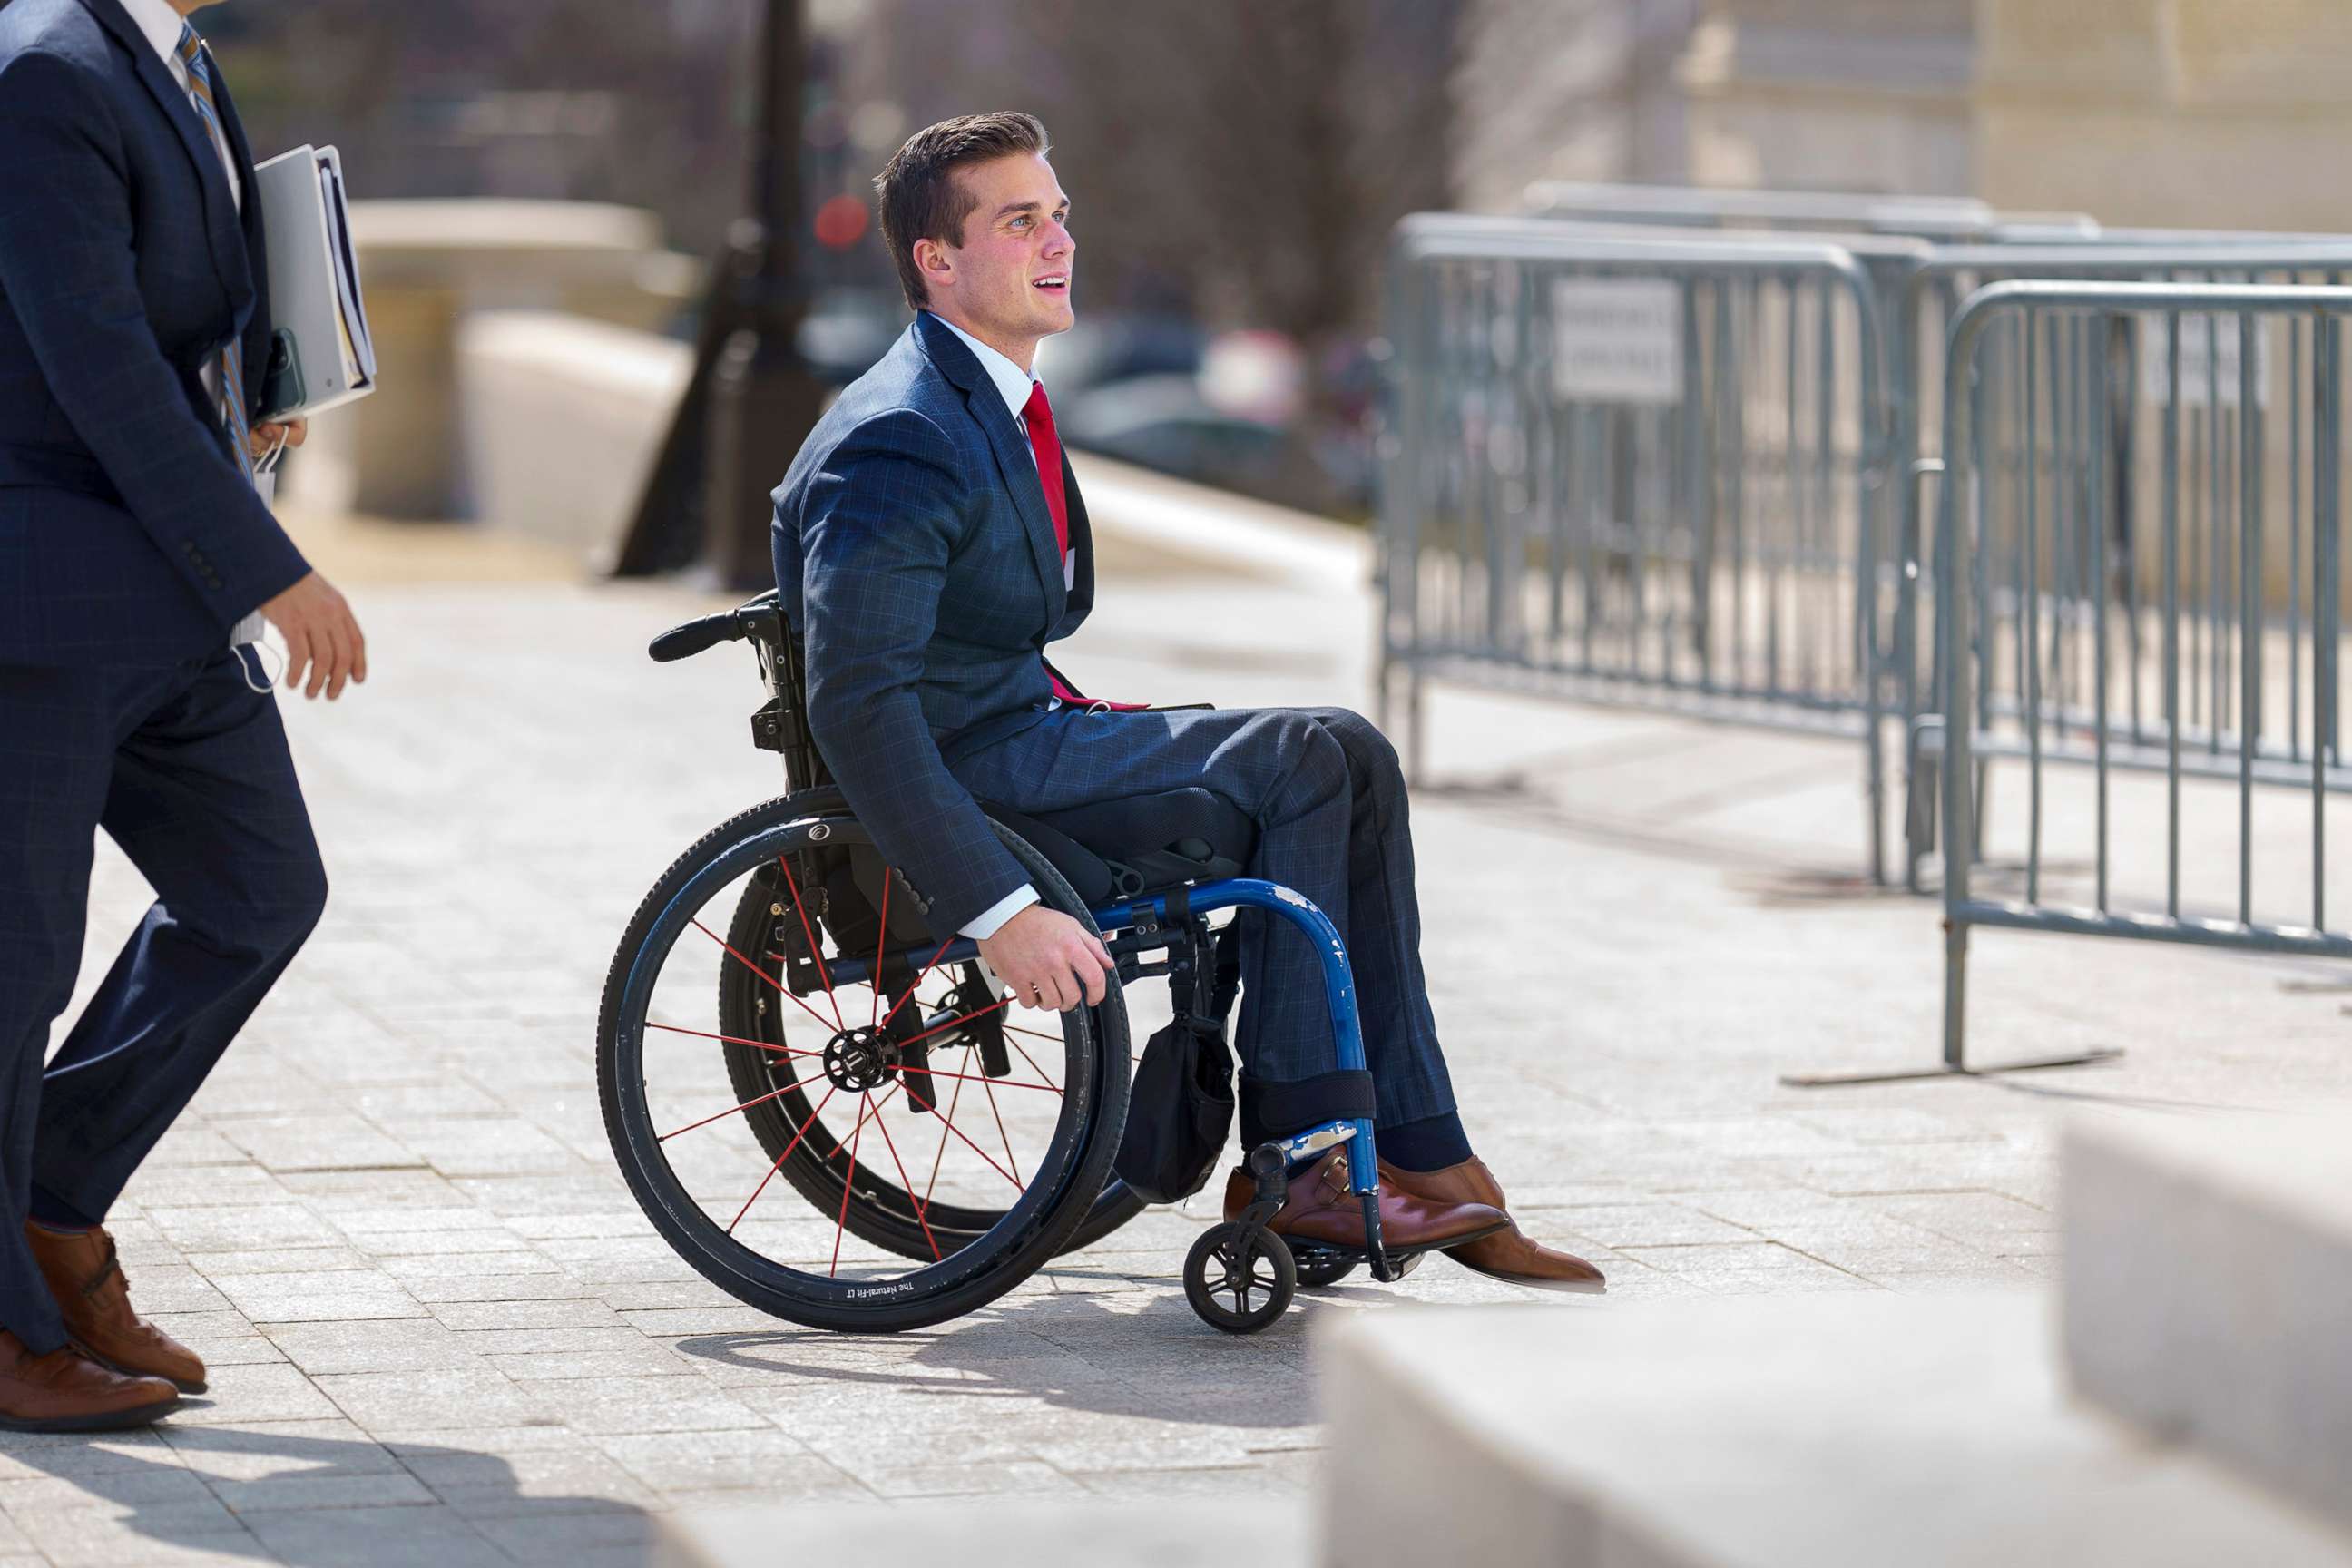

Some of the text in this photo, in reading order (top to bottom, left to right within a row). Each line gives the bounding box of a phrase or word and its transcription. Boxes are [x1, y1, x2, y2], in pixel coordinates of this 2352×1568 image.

[846, 1281, 914, 1298] The Natural-Fit LT
